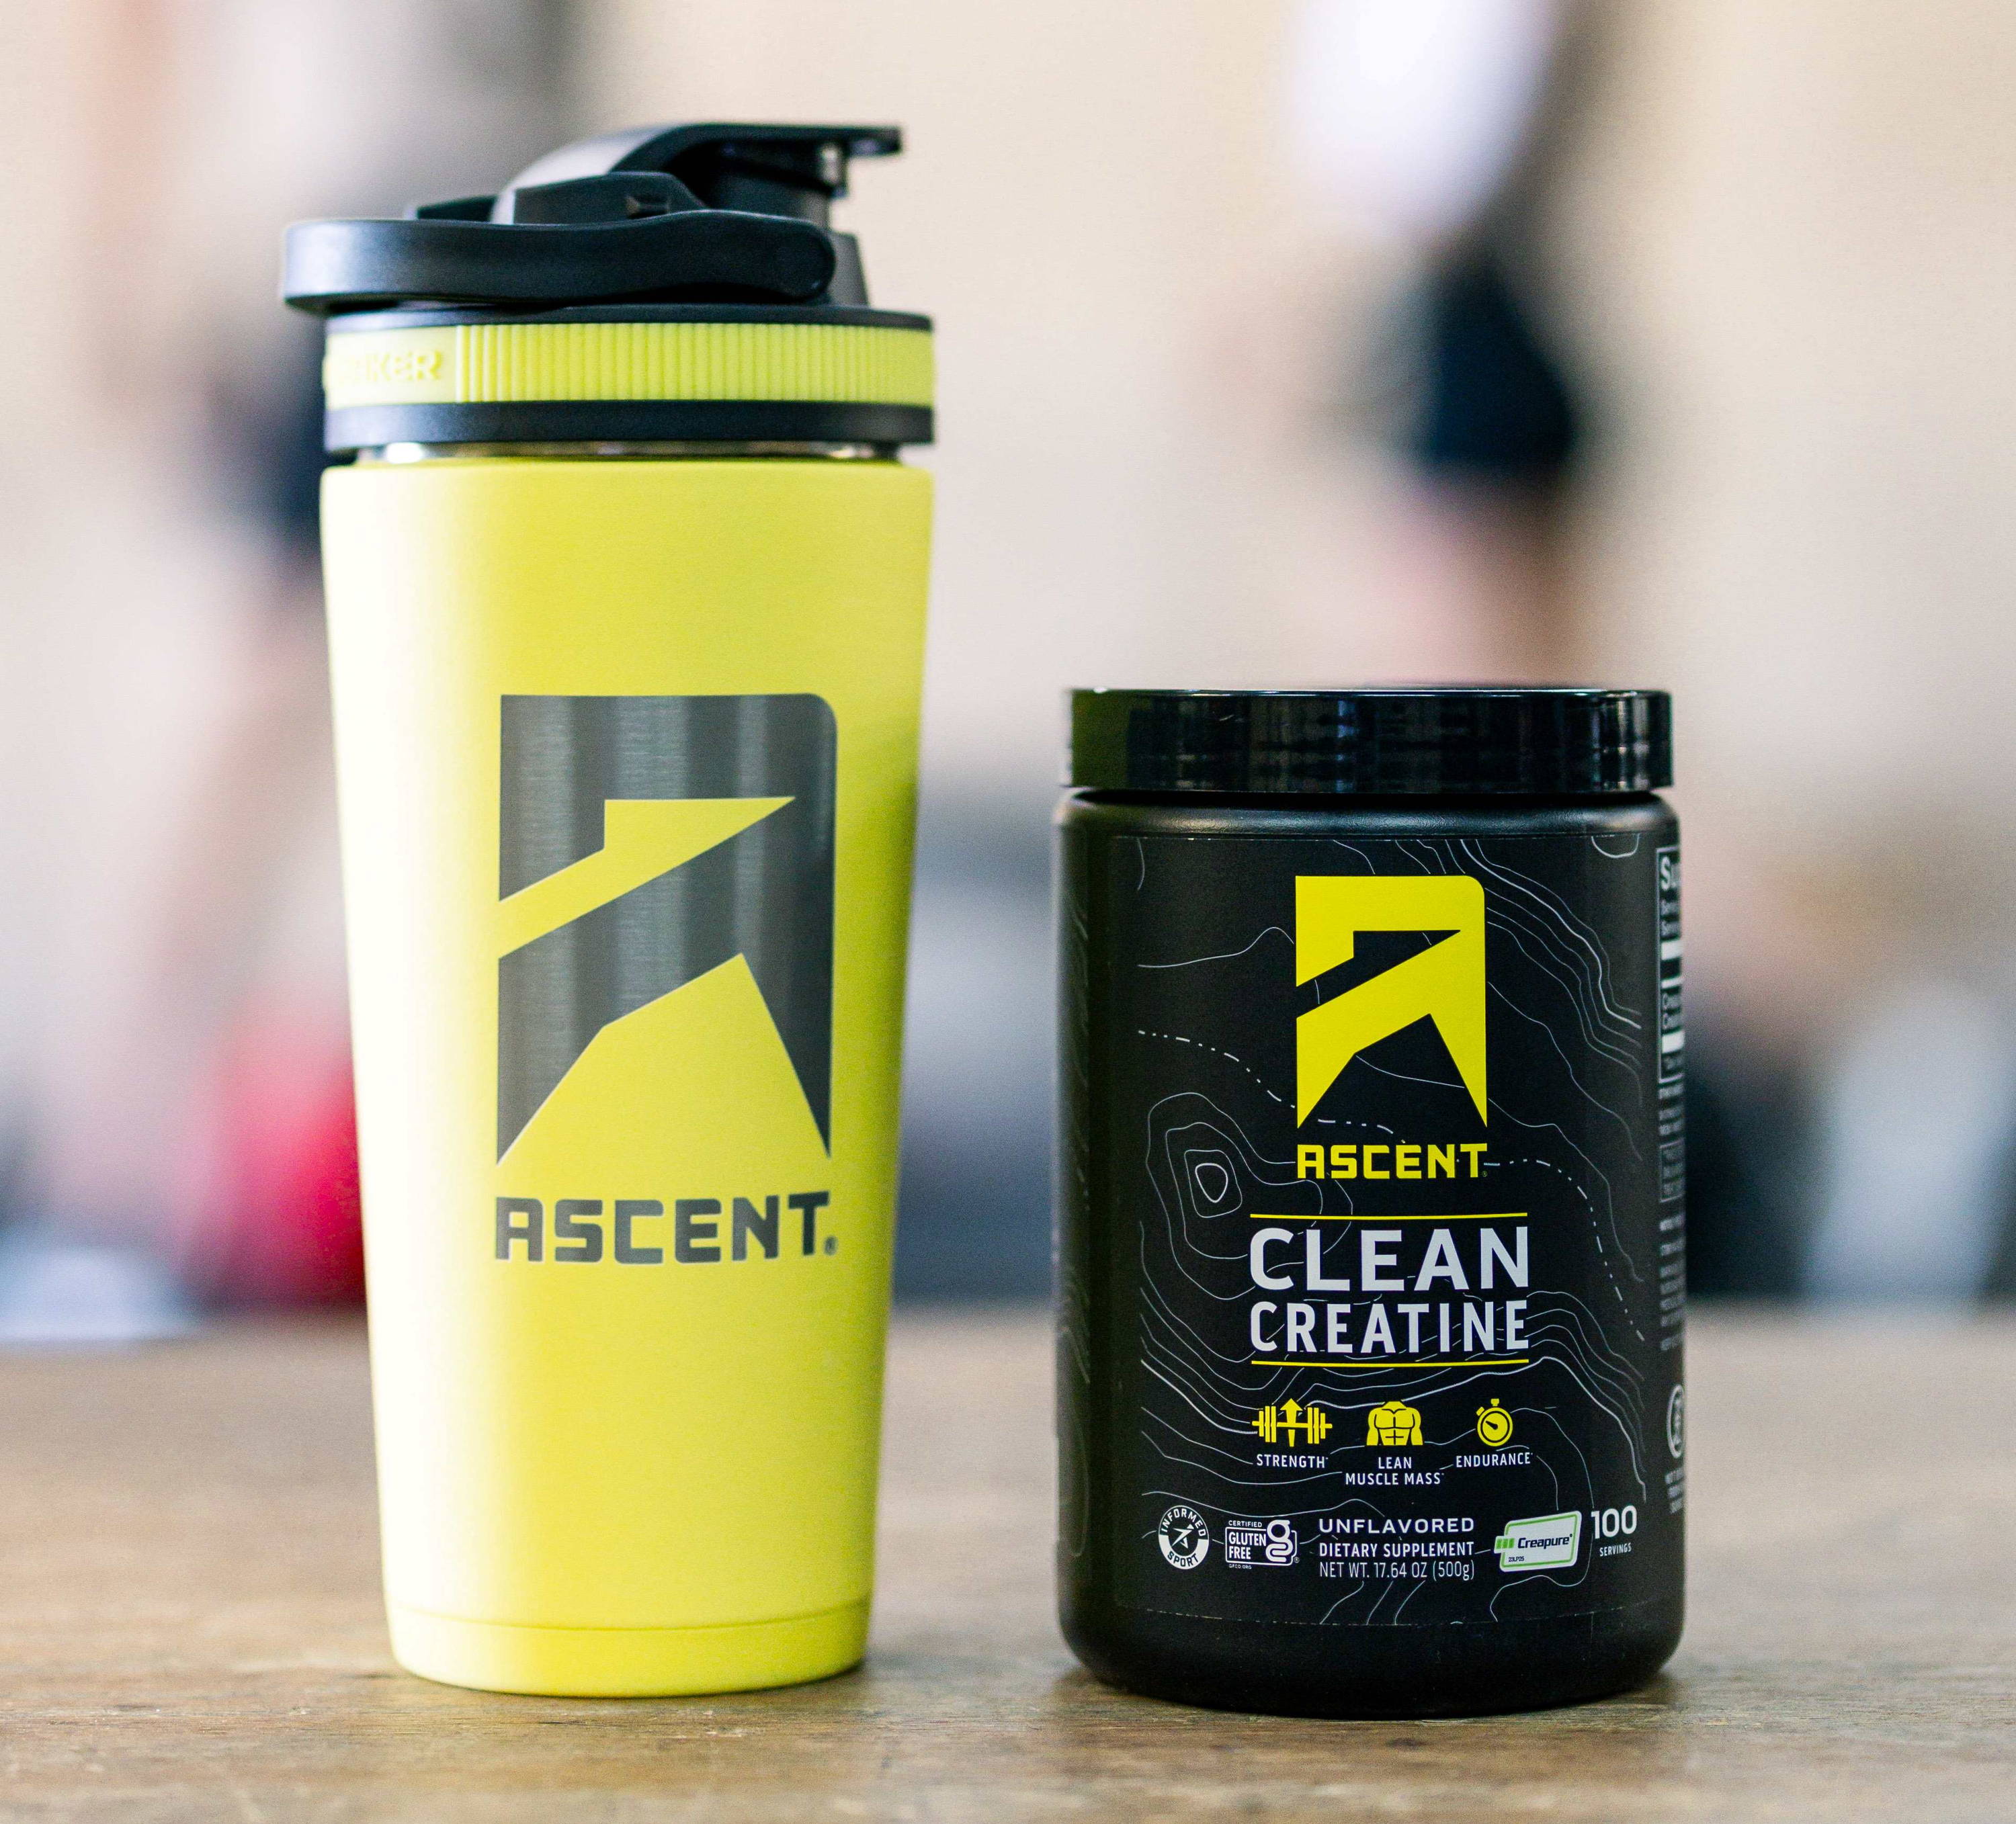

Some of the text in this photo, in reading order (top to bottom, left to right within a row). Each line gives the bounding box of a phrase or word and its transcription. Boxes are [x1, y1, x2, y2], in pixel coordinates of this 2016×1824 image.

[1297, 1143, 1488, 1179] ASCENT
[495, 1190, 829, 1264] ASCENT
[1250, 1226, 1529, 1291] CLEAN
[1250, 1299, 1529, 1354] CREATINE
[1257, 1454, 1325, 1469] STRENGTH
[1378, 1457, 1412, 1469] LEAN
[1456, 1452, 1531, 1469] ENDURANCE
[1345, 1472, 1441, 1485] MUSCLE MASS
[1161, 1508, 1206, 1537] INFORMED
[1228, 1520, 1263, 1528] CERTIFIED
[1318, 1518, 1474, 1533] UNFLAVORED
[1591, 1505, 1638, 1540] 100
[1228, 1532, 1267, 1547] GLUTEN
[1517, 1536, 1570, 1550] Creapure
[1228, 1547, 1251, 1560] FREE
[1319, 1541, 1474, 1557] DIETARY SUPPLEMENT
[1599, 1543, 1632, 1557] SERVINGS
[1167, 1552, 1199, 1567] SPORT
[1319, 1559, 1475, 1581] NET WT. 17.64 OZ (500g)
